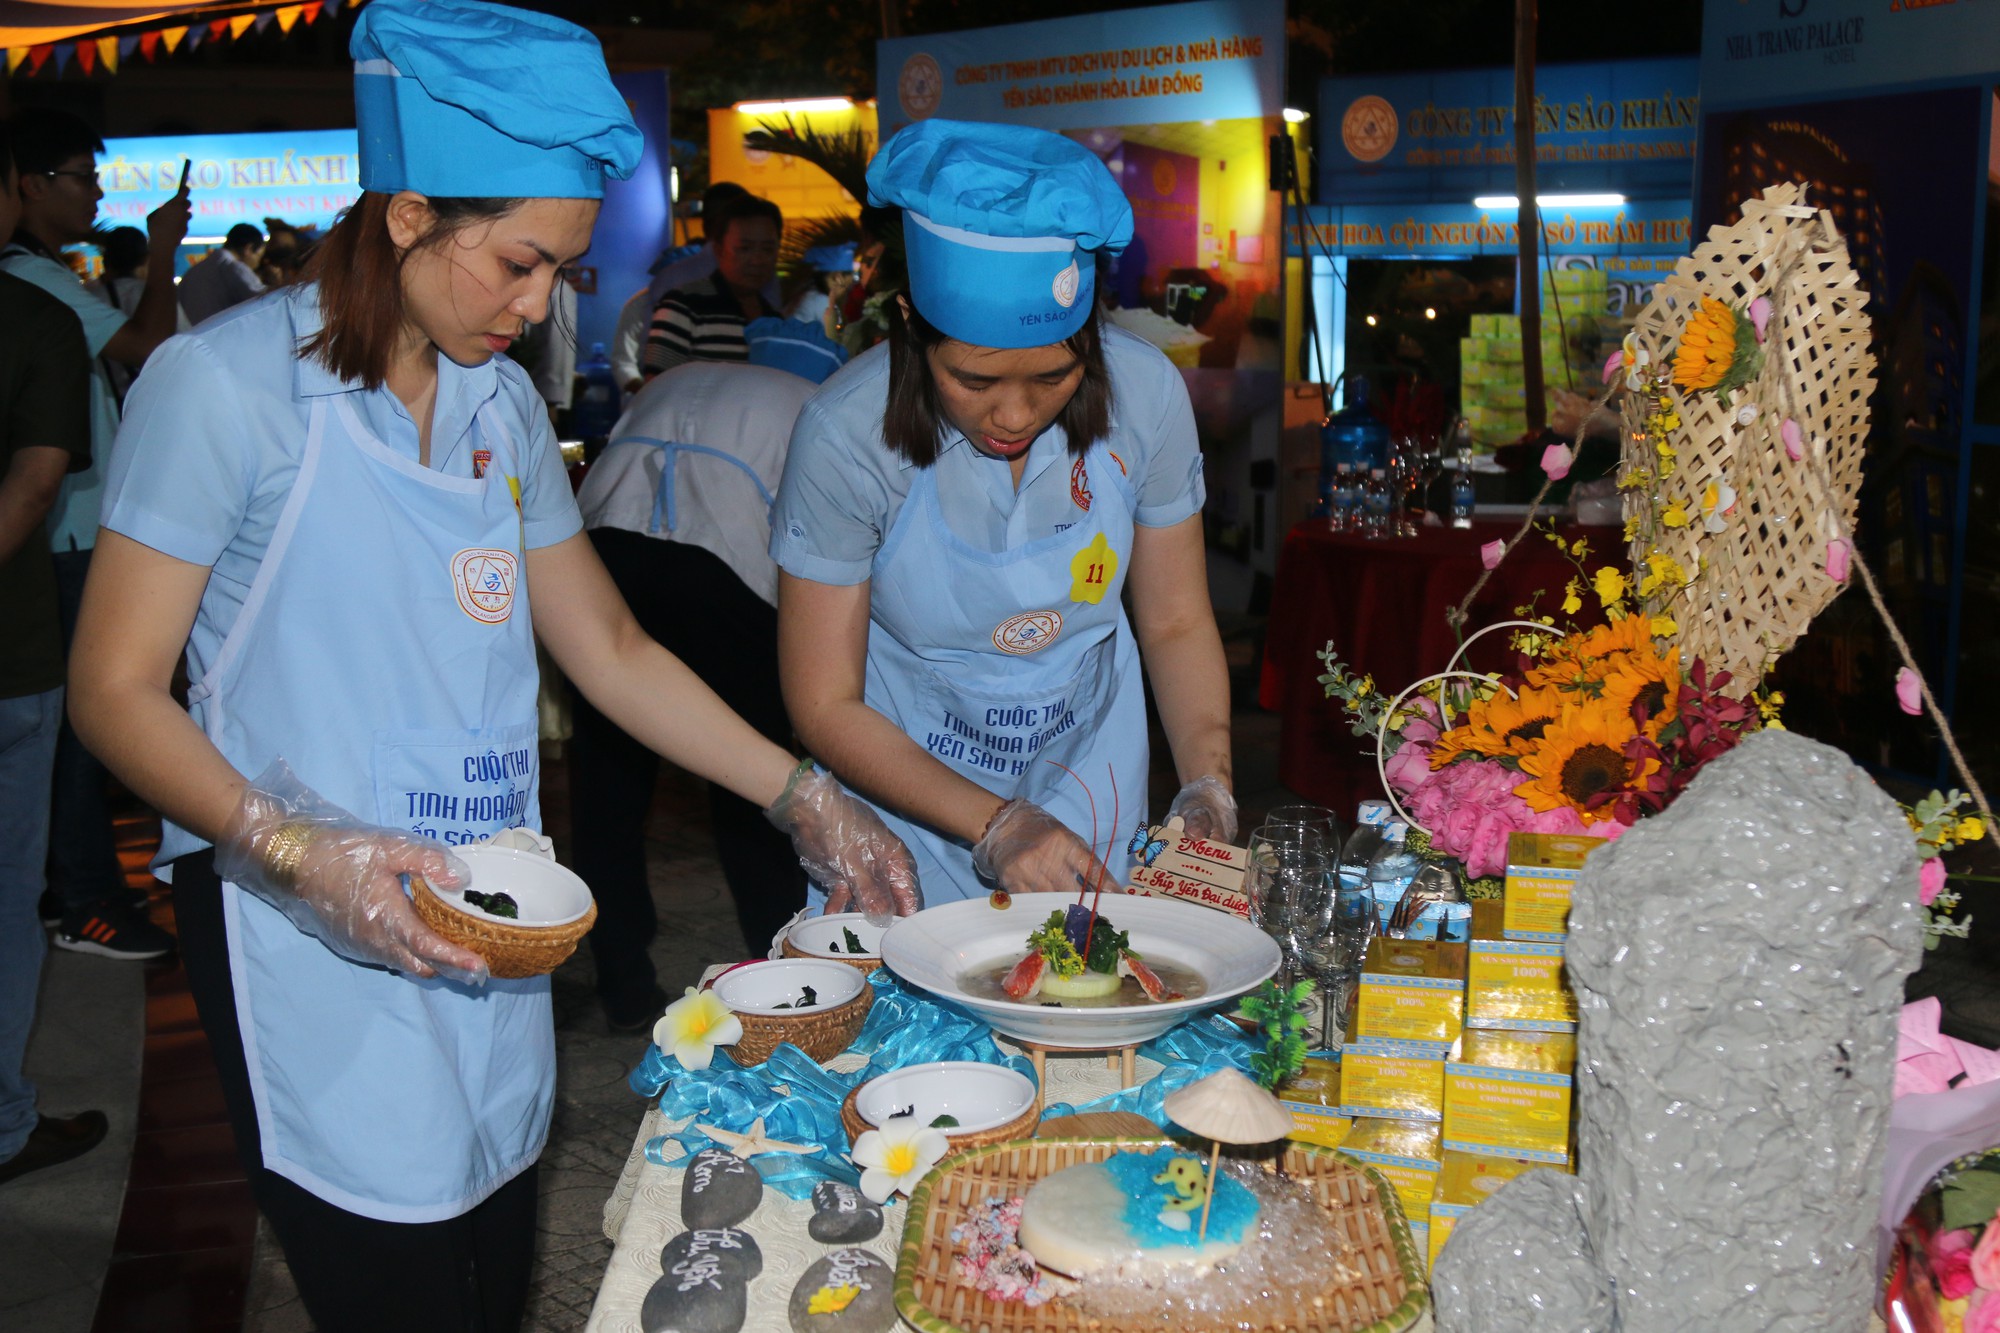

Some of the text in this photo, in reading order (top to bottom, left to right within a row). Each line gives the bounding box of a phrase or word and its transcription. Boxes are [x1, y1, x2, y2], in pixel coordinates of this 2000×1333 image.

[1757, 26, 1803, 57] TRANG
[1806, 16, 1865, 50] PALACE
[1040, 56, 1066, 76] MTV
[1068, 52, 1099, 77] DỊCH
[1101, 49, 1119, 74] VỤ
[1121, 49, 1141, 68] DU
[1143, 46, 1173, 71] LỊCH
[1175, 44, 1186, 64] &
[1188, 37, 1218, 62] NHÀ
[1221, 35, 1263, 60] HÀNG
[1823, 47, 1857, 65] HOTEL
[1100, 77, 1128, 100] HÒA
[1130, 75, 1160, 98] LÂM
[1408, 102, 1472, 138] CÔNG
[1477, 107, 1508, 135] TY
[1565, 94, 1615, 132] SÀO
[228, 149, 348, 188] KHÁNH
[1342, 224, 1385, 246] HOA
[1389, 217, 1426, 250] CỘI
[1429, 213, 1507, 246] NGUỒN
[1545, 213, 1576, 244] SỞ
[1085, 563, 1104, 584] 11
[985, 698, 1066, 729] CUỘC THI
[943, 710, 980, 743] TINH
[985, 733, 1023, 754] HOA
[464, 749, 530, 784] CUỘC THI
[926, 732, 965, 760] YẾN
[967, 746, 1006, 774] SÀO
[405, 792, 458, 821] TINH
[464, 795, 506, 823] HOA
[1178, 837, 1233, 861] Menu
[1512, 966, 1550, 978] 100%
[1395, 997, 1426, 1008] 100%
[1378, 1067, 1408, 1078] 100%
